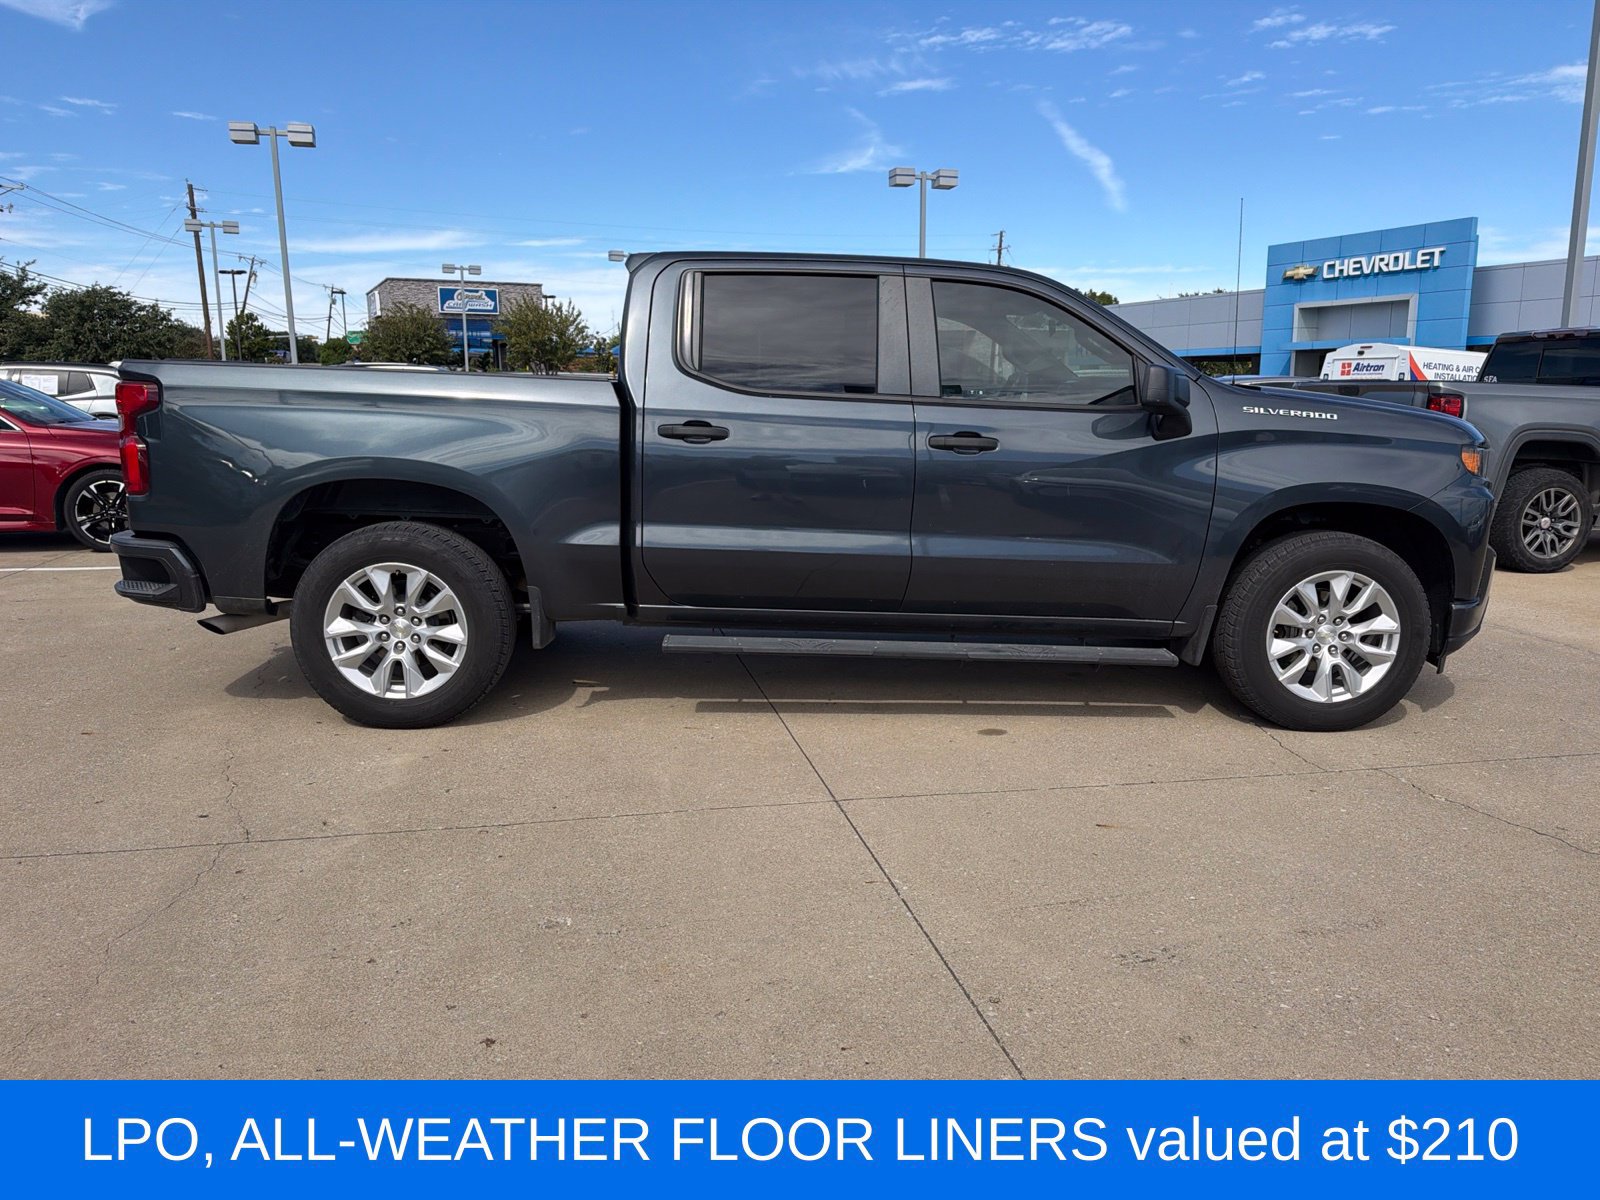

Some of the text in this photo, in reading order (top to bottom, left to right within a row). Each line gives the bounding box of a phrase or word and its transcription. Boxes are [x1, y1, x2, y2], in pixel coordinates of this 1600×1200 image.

[1322, 247, 1446, 279] CHEVROLET
[1353, 362, 1385, 372] Airtron
[1423, 362, 1454, 372] HEATING
[1462, 365, 1474, 373] AIR
[1242, 406, 1338, 420] SILVERADO
